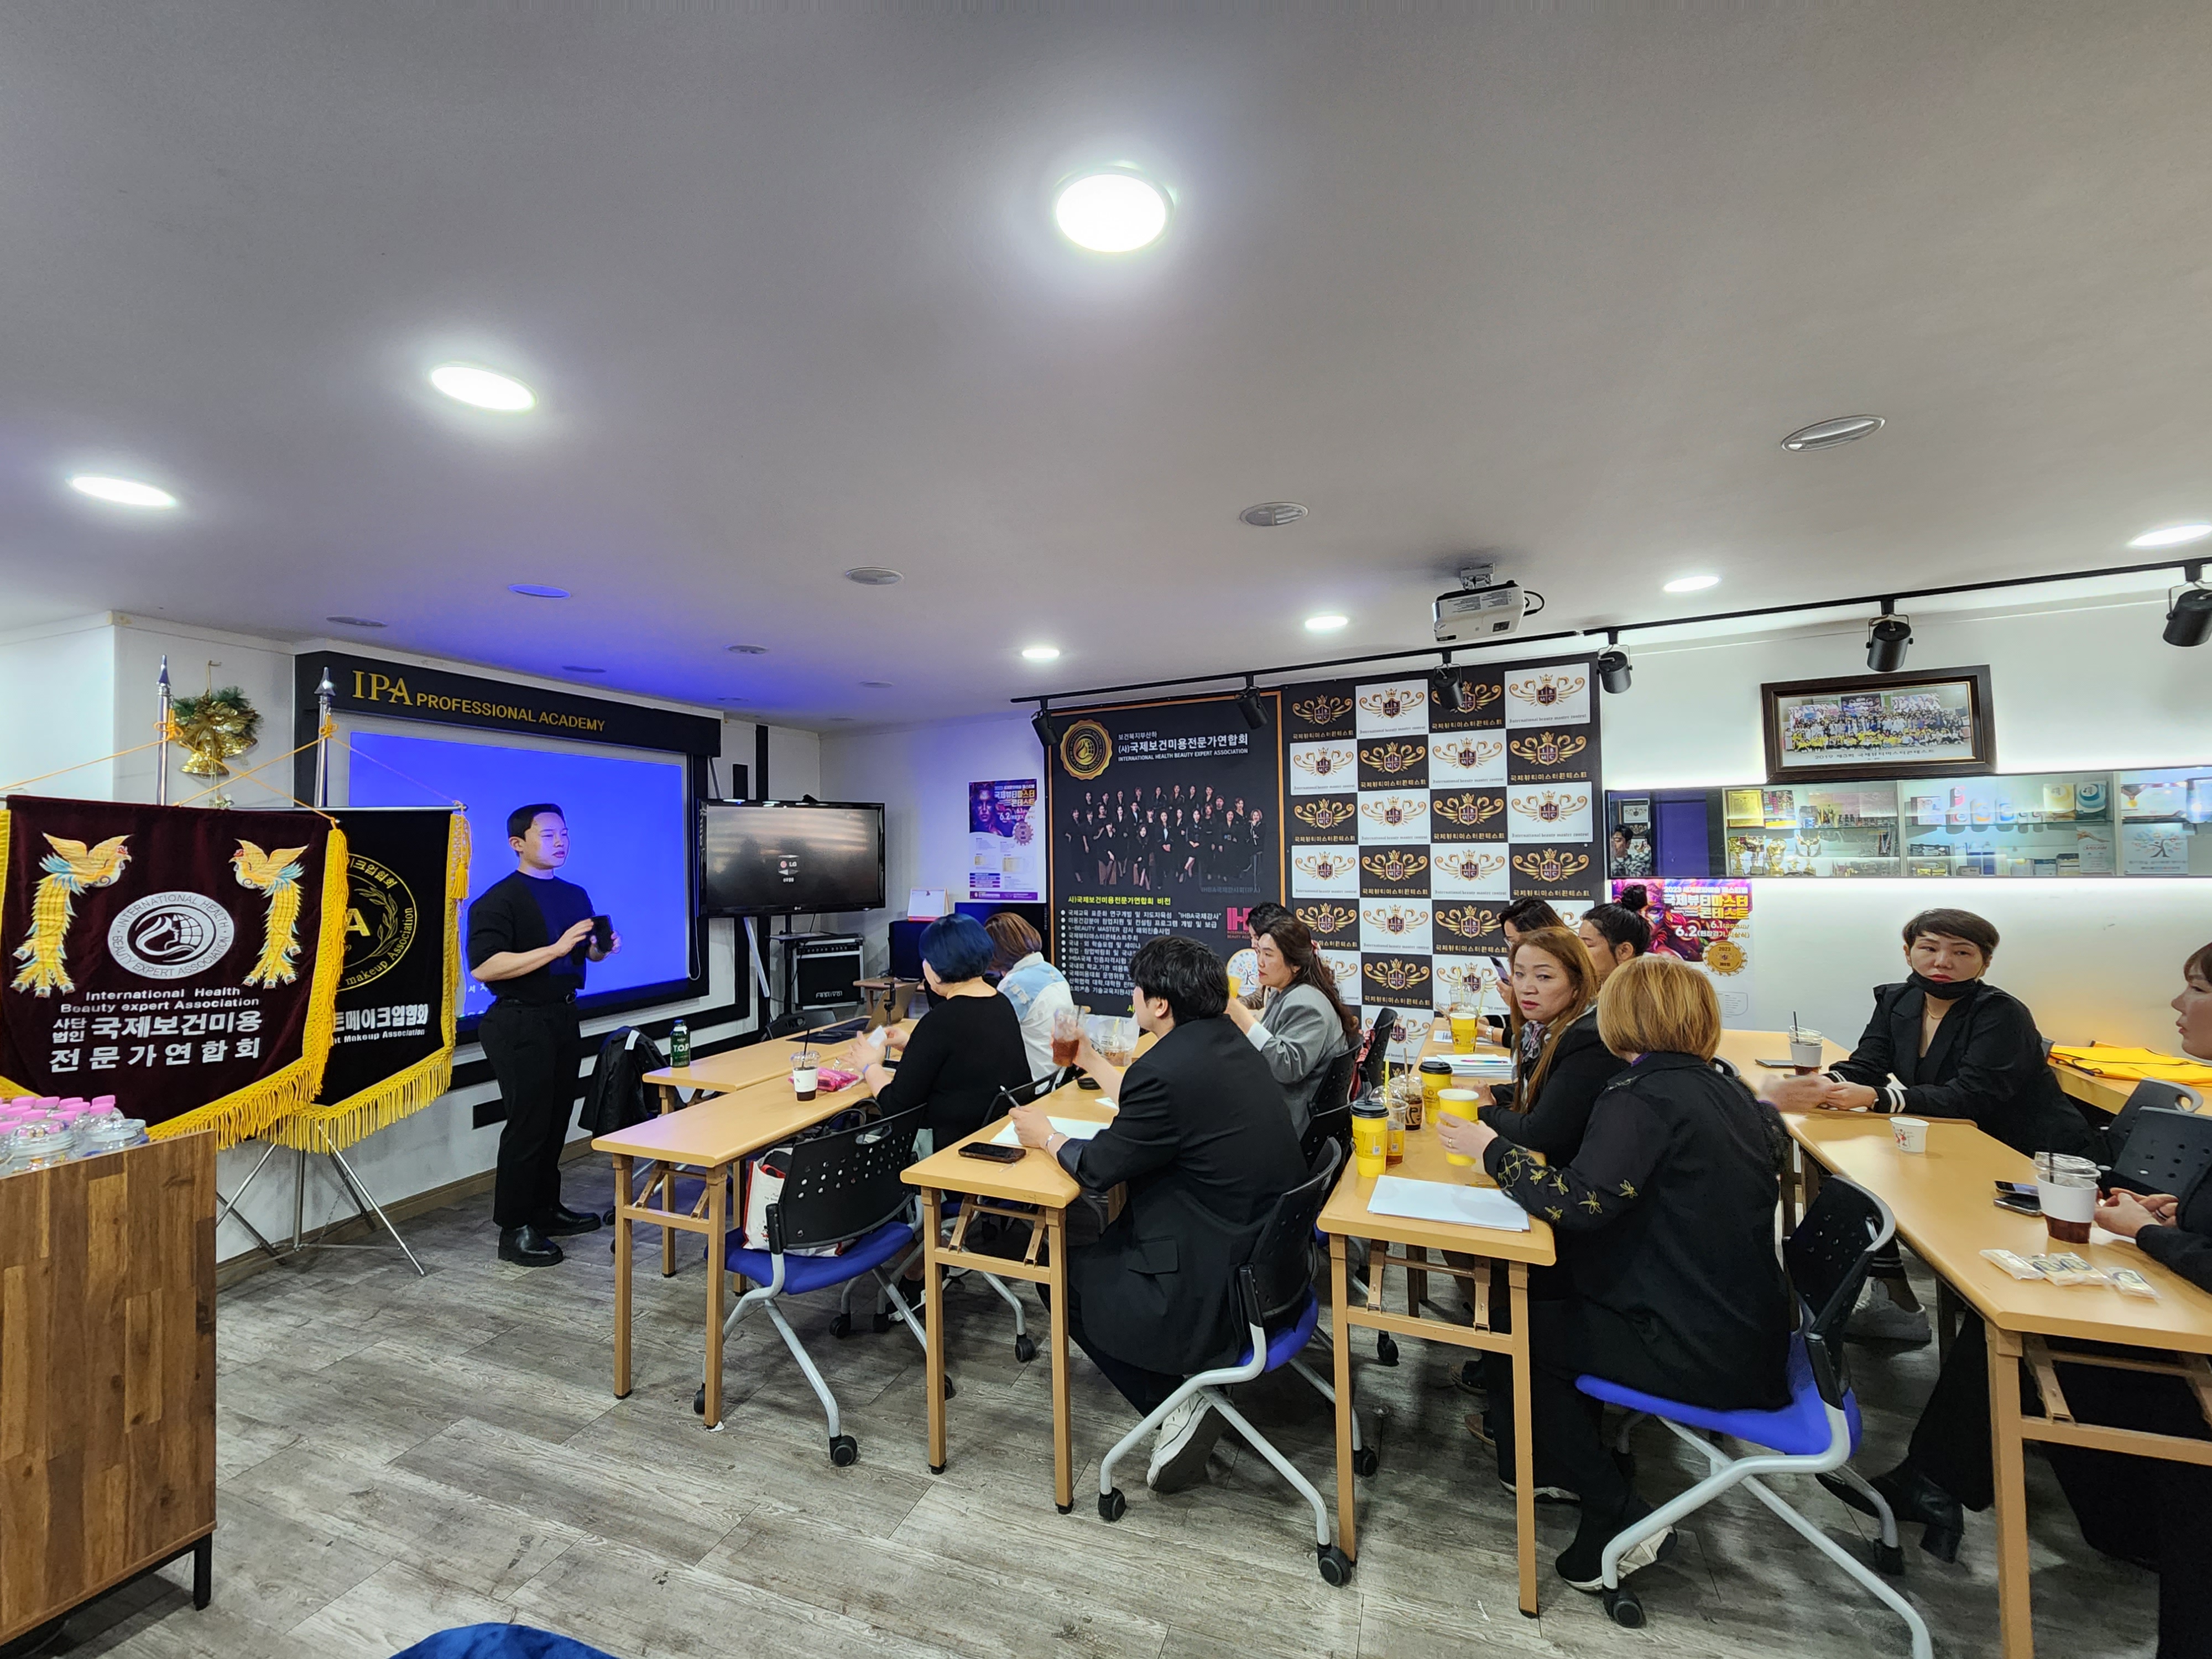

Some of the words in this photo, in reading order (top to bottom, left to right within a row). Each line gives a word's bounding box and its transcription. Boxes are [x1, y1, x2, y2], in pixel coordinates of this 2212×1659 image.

[352, 670, 413, 706] IPA
[416, 692, 536, 723] PROFESSIONAL
[538, 711, 606, 732] ACADEMY
[1118, 731, 1157, 740] 보건복지부산하
[1118, 733, 1248, 753] (사)국제보건미용전문가연합회
[1214, 748, 1248, 757] ASSOCIATION
[1157, 897, 1171, 905] 비전
[1663, 894, 1748, 907] 국제뷰티마스터
[117, 894, 197, 927] INTERNATIONAL
[200, 900, 229, 927] HEALTH
[1699, 907, 1749, 919] 콘테스트
[345, 960, 388, 985] makeup
[387, 907, 414, 961] Association
[112, 936, 135, 964] BEAUTY
[133, 963, 174, 977] EXPERT
[178, 936, 230, 975] ASSOCIATION
[86, 988, 185, 1001] International
[195, 987, 240, 997] Health
[61, 1004, 116, 1013] Beauty
[122, 1001, 169, 1012] expert
[174, 998, 259, 1010] Association
[53, 1018, 87, 1031] 사단
[91, 1010, 262, 1040] 국제보건미용
[52, 1030, 86, 1044] 법인
[344, 1032, 379, 1044] Makeup
[382, 1029, 425, 1039] Association
